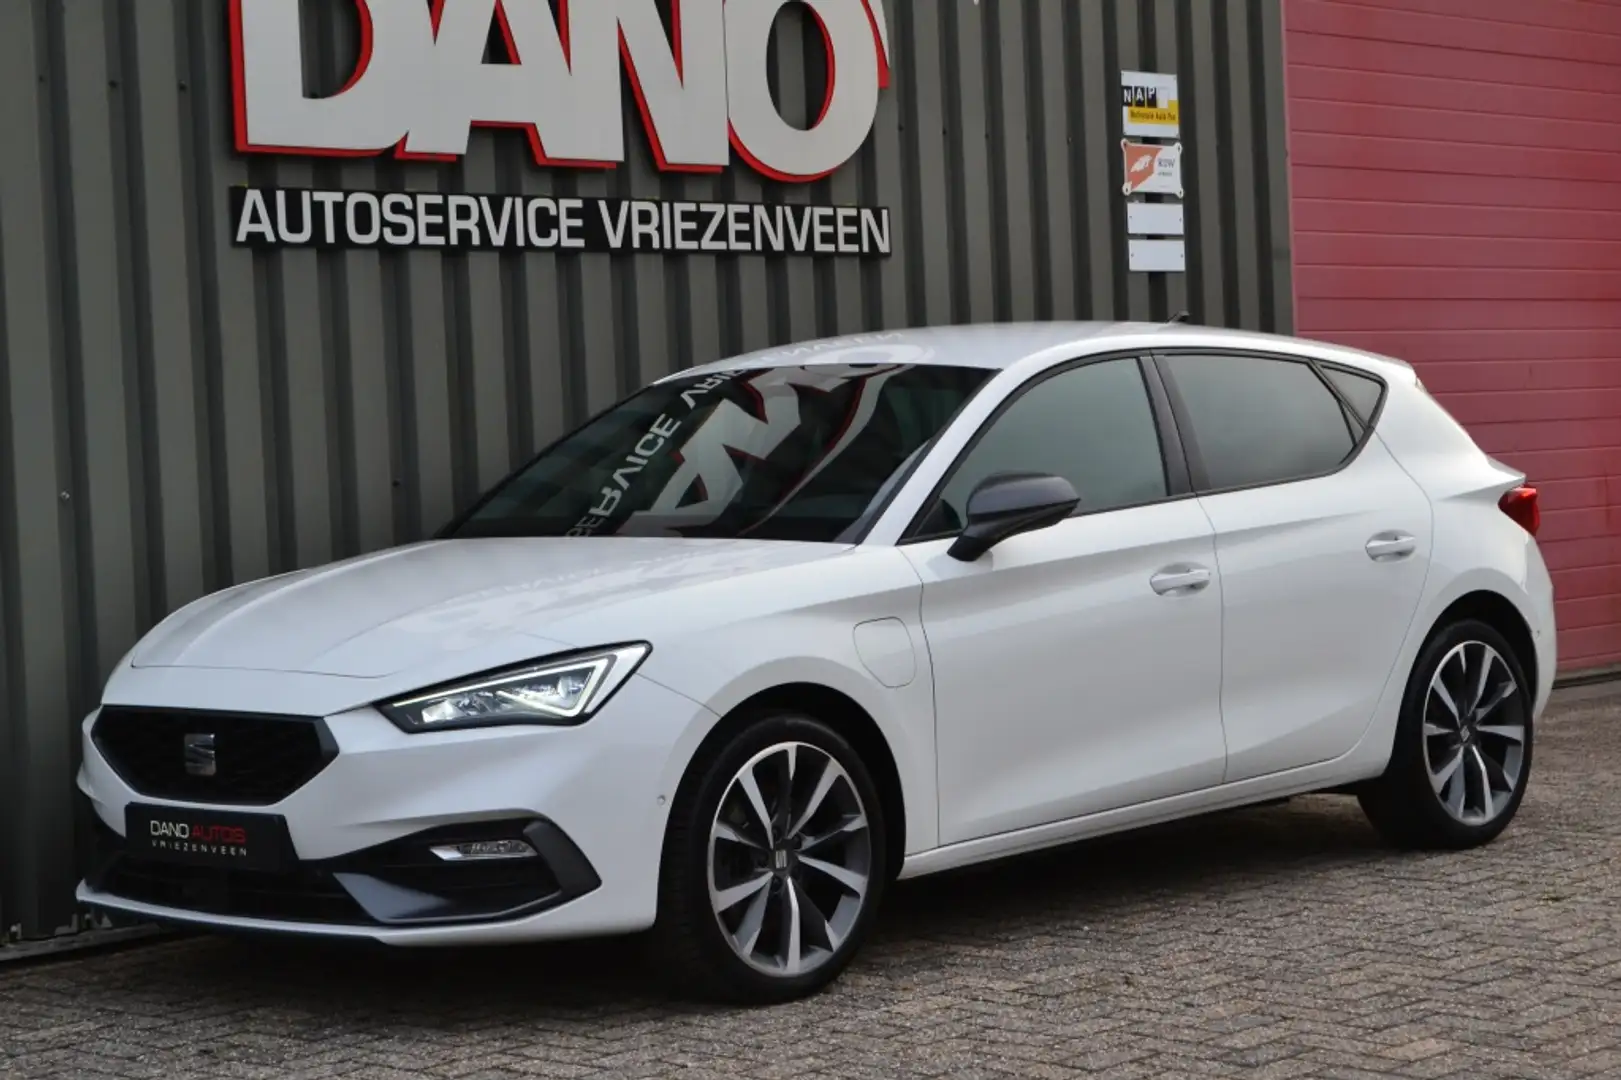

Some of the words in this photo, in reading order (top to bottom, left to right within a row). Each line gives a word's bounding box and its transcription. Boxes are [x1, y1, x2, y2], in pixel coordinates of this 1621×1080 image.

[229, 0, 880, 183] DANO
[1123, 87, 1156, 103] NAP
[236, 189, 585, 248] AUTOSERVICE
[598, 200, 890, 254] VRIEZENVEEN
[150, 820, 189, 839] DANO
[191, 824, 246, 844] AUTOS
[151, 840, 247, 856] VRIEZENVEEN
